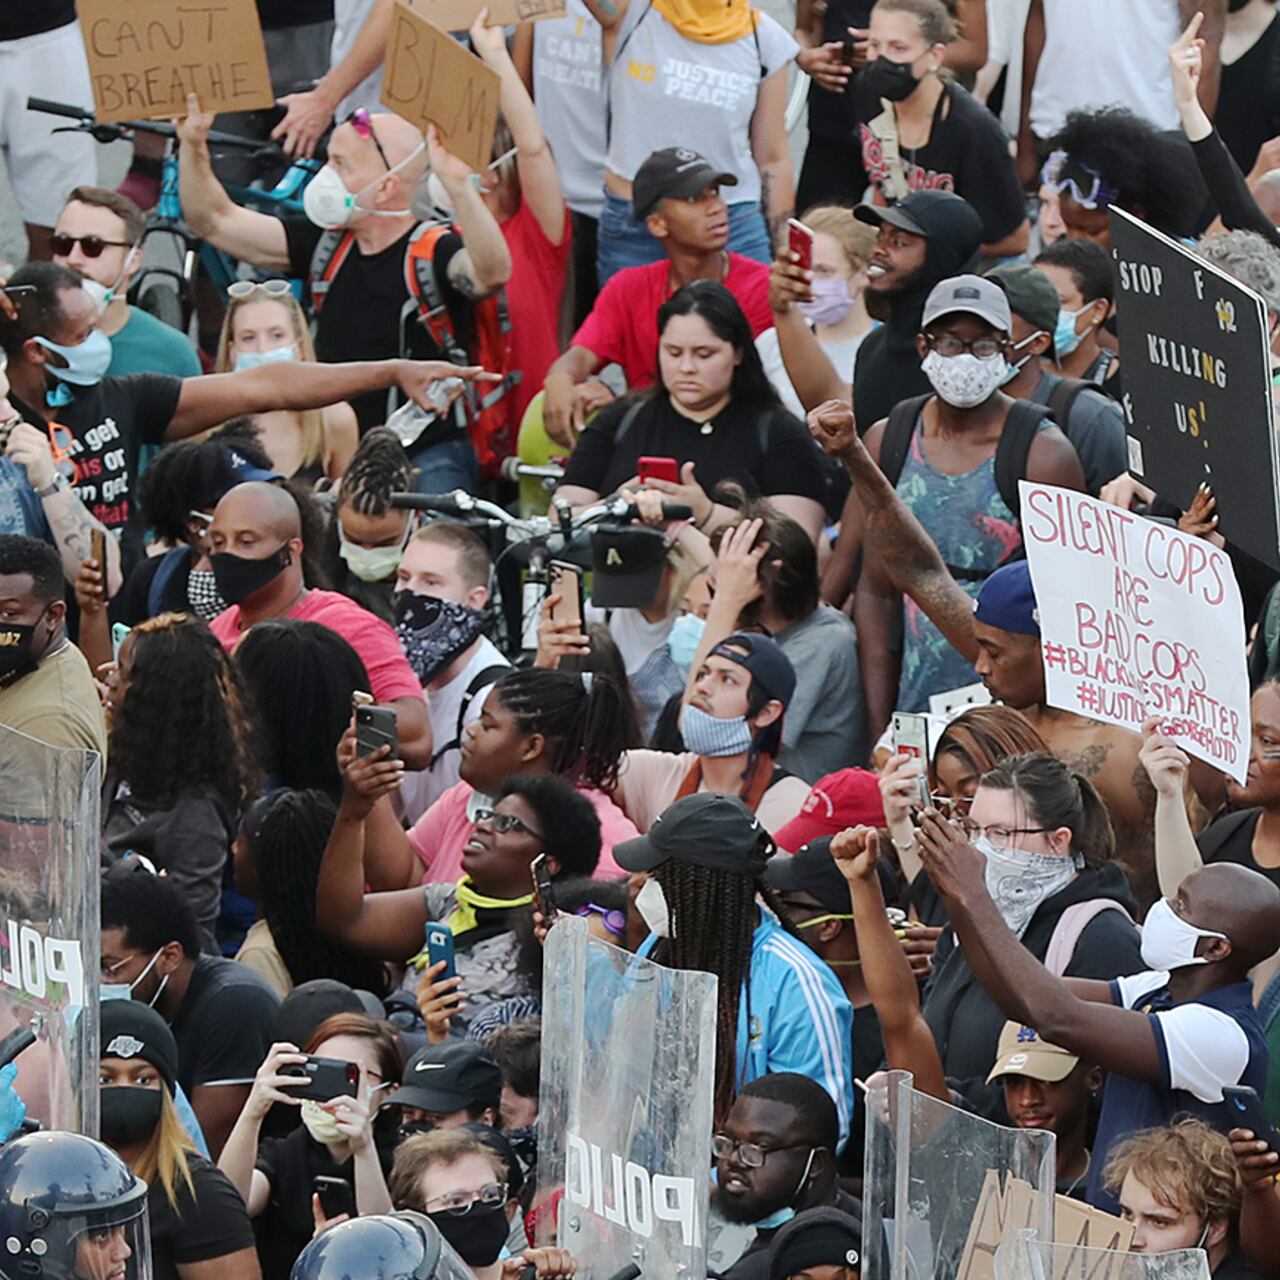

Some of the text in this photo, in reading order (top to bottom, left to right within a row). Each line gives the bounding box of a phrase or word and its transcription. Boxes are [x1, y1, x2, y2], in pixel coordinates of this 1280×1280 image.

[94, 61, 262, 113] BREATHE
[387, 15, 489, 167] BLM
[662, 57, 753, 95] JUSTICE
[663, 78, 743, 110] PEACE
[1118, 260, 1163, 297] STOP
[1146, 332, 1228, 389] KILLING
[83, 417, 121, 452] get
[104, 448, 126, 472] or
[102, 471, 129, 503] get
[605, 547, 624, 566] A
[1027, 489, 1225, 606] SILENT COPS
[1114, 566, 1154, 627] ARE
[1075, 601, 1208, 693] BAD COPS
